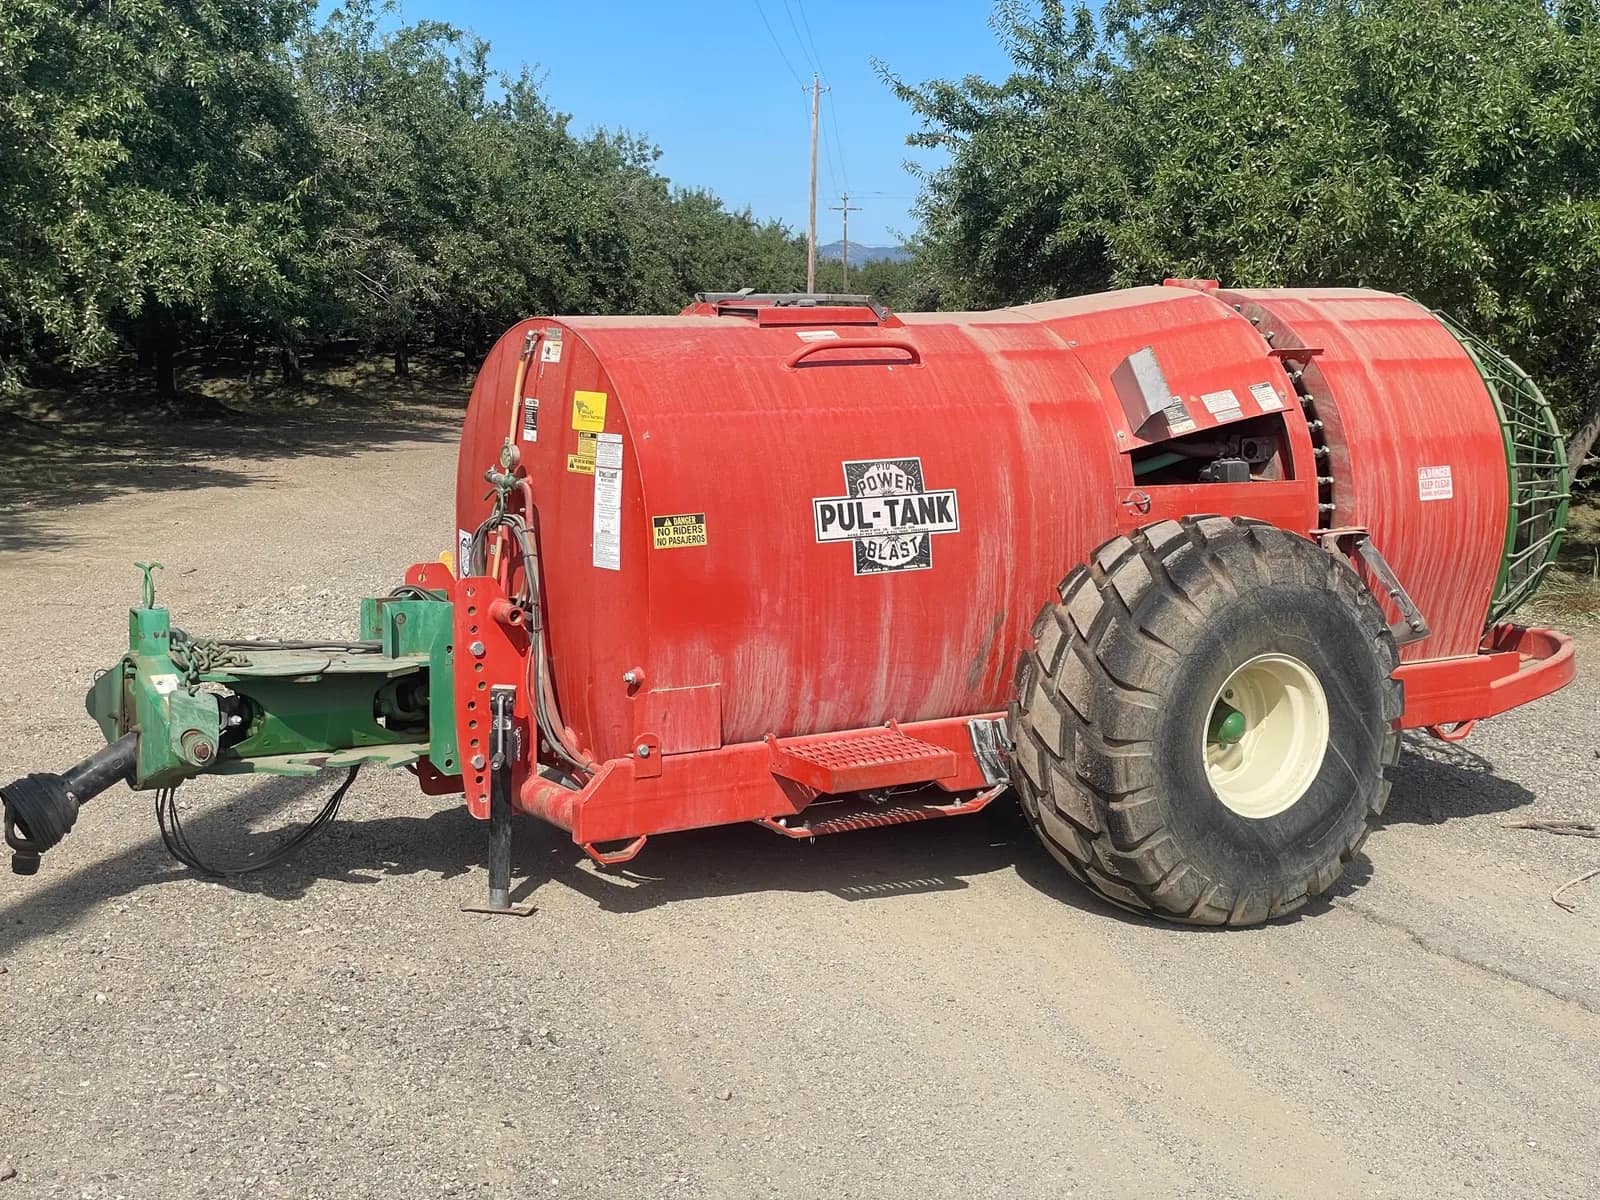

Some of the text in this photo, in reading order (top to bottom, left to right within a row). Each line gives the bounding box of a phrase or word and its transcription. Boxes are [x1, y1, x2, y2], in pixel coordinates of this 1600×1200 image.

[858, 472, 914, 496] POWER
[673, 515, 697, 525] DANGER
[820, 495, 953, 532] PUL-TANK
[657, 525, 704, 536] NO RIDERS
[656, 534, 706, 547] NO PASAJEROS
[866, 536, 920, 561] BLAST
